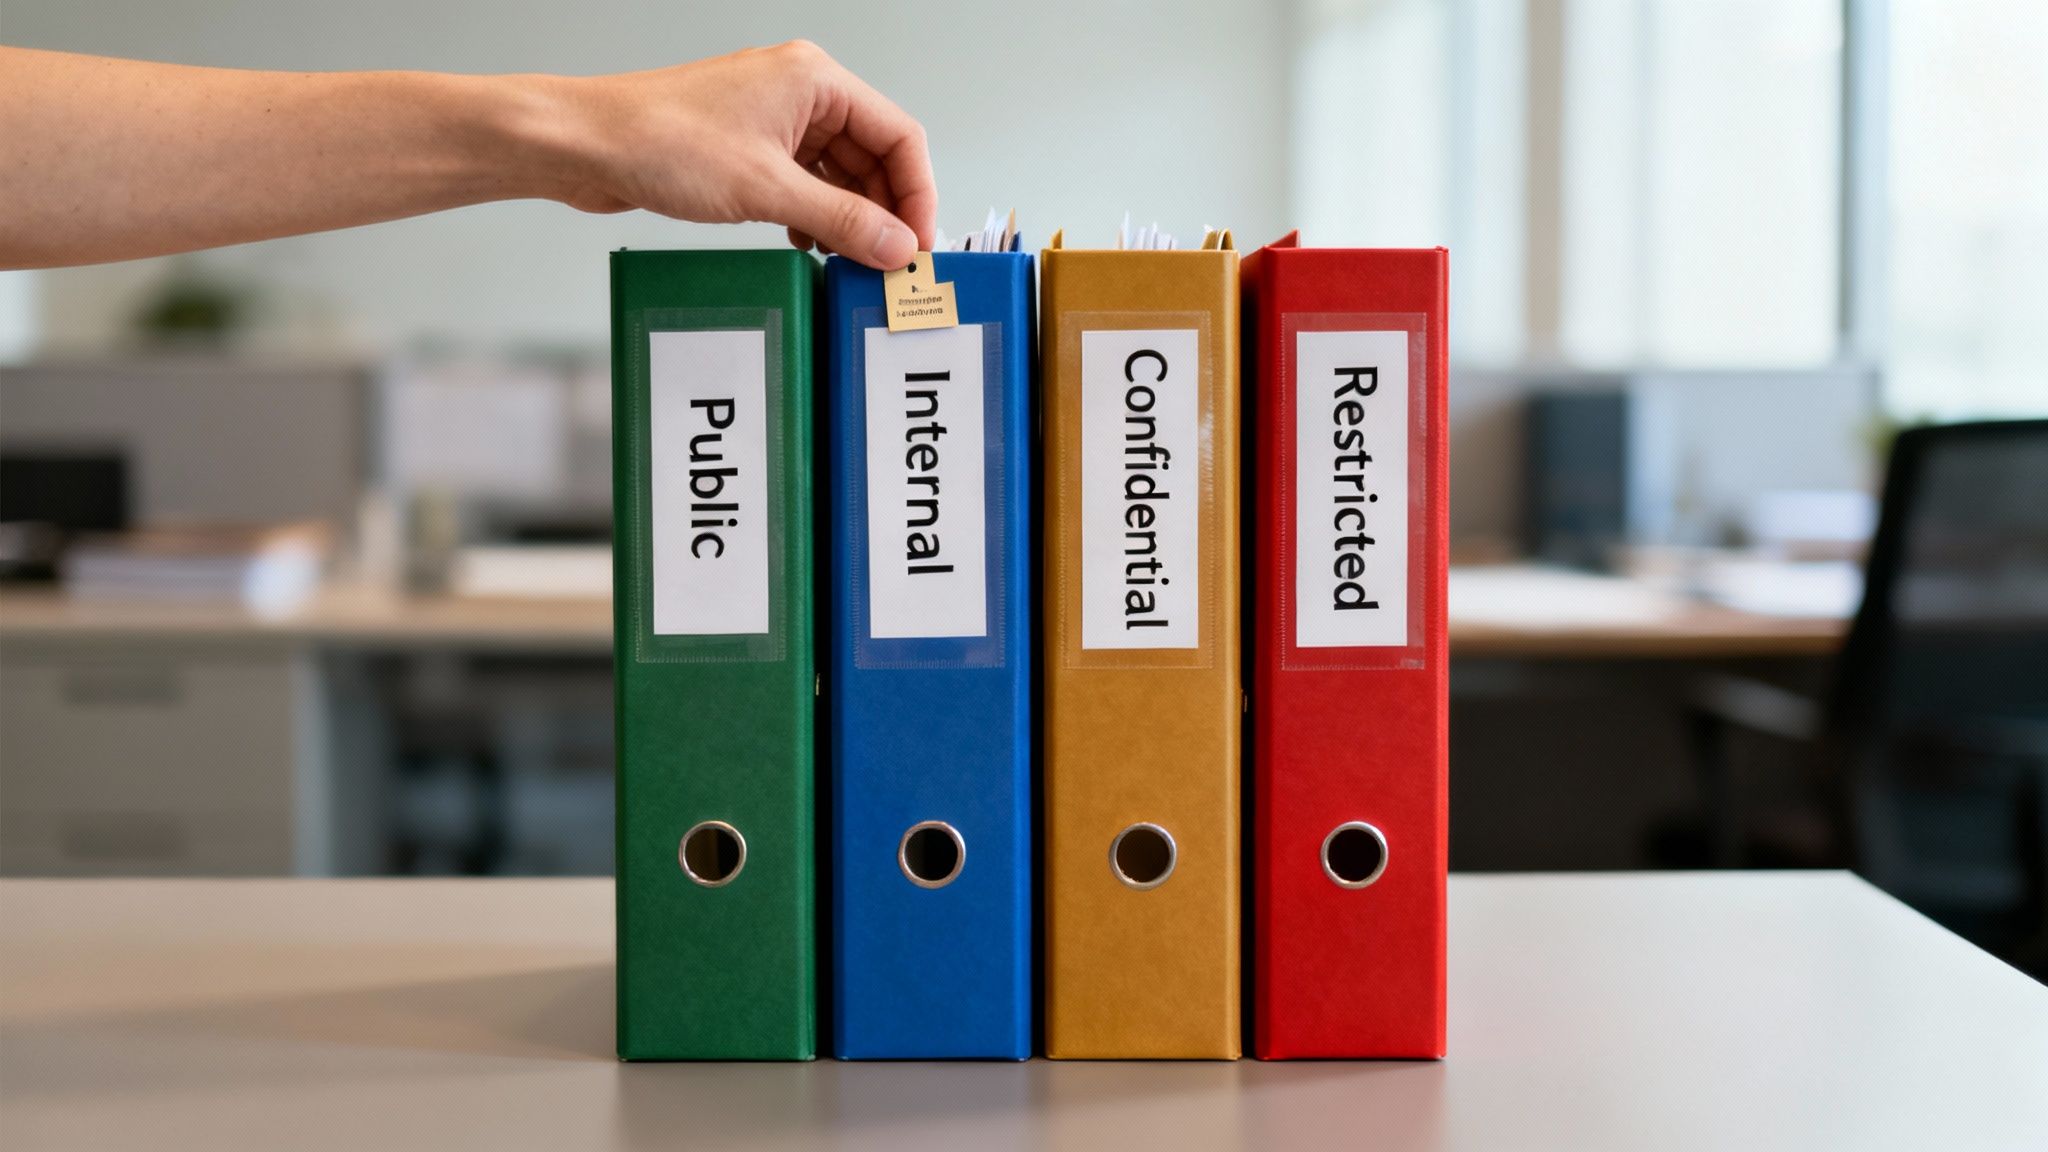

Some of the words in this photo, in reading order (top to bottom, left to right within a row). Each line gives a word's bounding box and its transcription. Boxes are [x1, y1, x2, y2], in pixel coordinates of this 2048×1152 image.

[688, 397, 740, 559] Public
[904, 370, 954, 576] Internal
[1124, 349, 1171, 631] Confidential
[1333, 366, 1380, 611] Restricted
